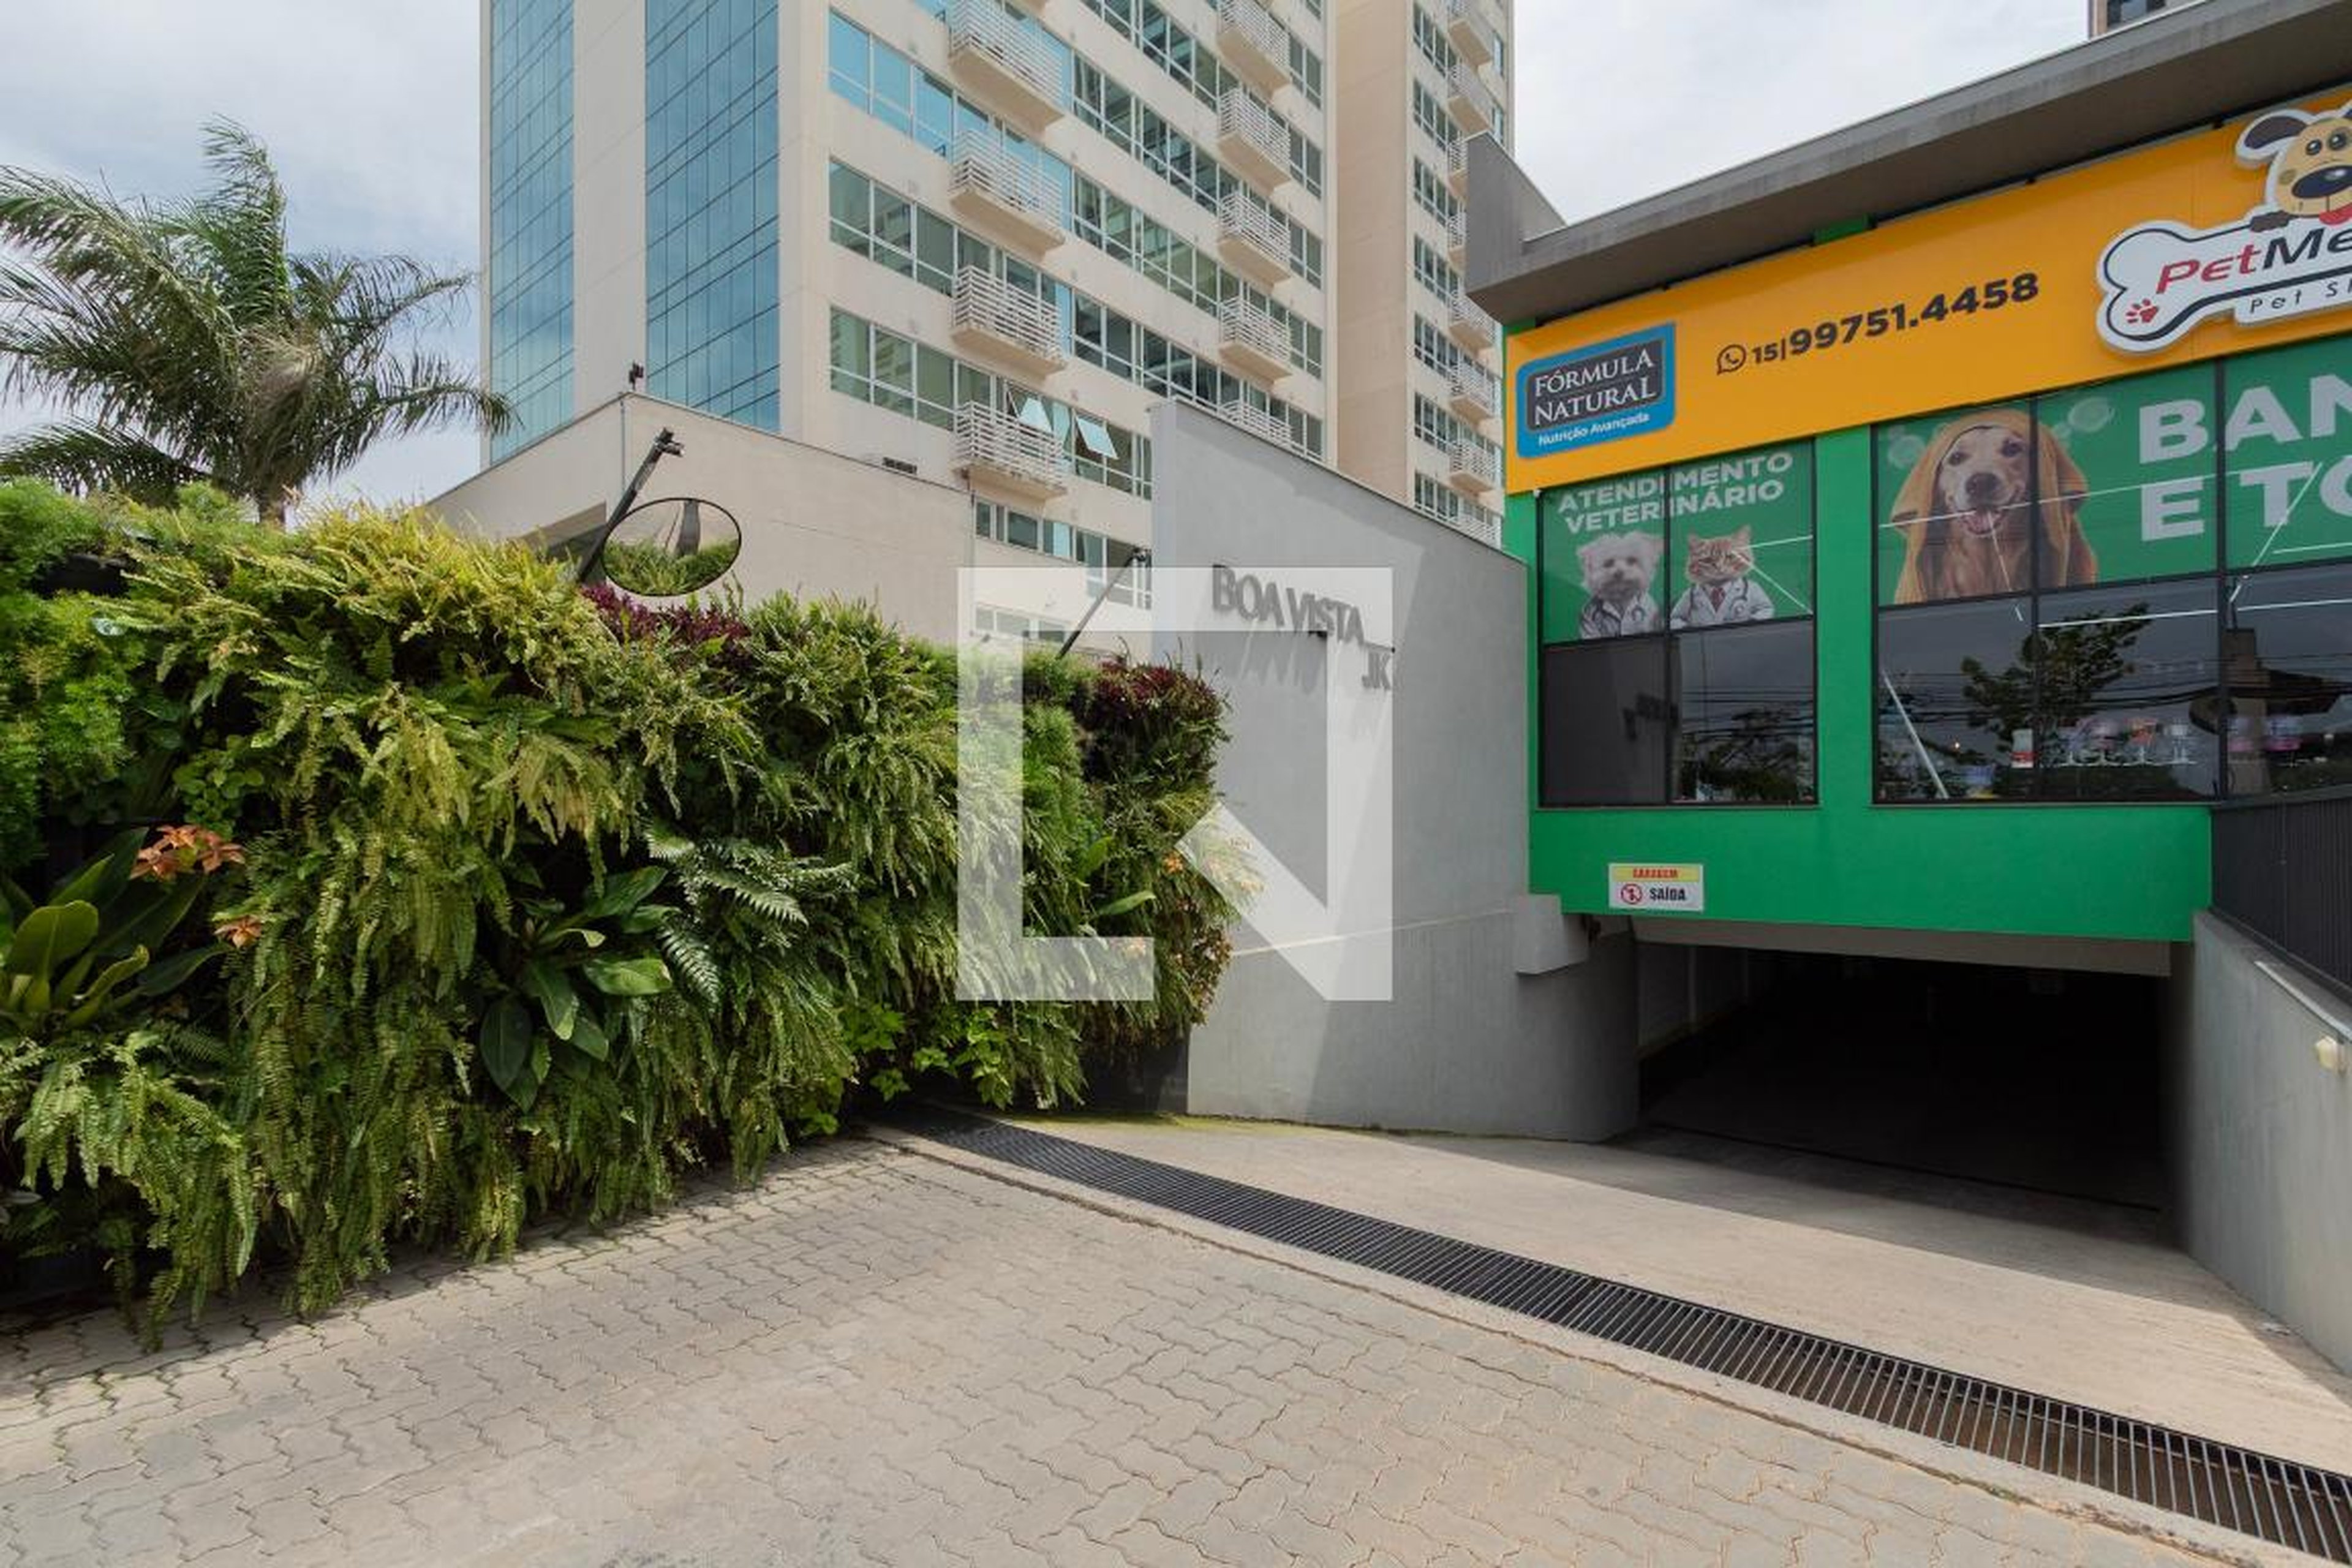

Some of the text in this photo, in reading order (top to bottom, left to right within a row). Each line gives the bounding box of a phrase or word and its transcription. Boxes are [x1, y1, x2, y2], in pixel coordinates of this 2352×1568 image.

[2250, 278, 2352, 314] Pet S
[1535, 349, 1654, 397] FÓRMULA
[1535, 377, 1656, 425] NATURAL
[1538, 412, 1650, 447] Nutrição Avançada
[1558, 452, 1793, 514] ATENDIMENTO
[1566, 480, 1784, 534] VETERINÁRIO
[2141, 477, 2205, 541] E
[1212, 564, 1365, 644] BOA VISTA
[1361, 650, 1393, 691] JK
[1649, 886, 1686, 901] SAÍDA
